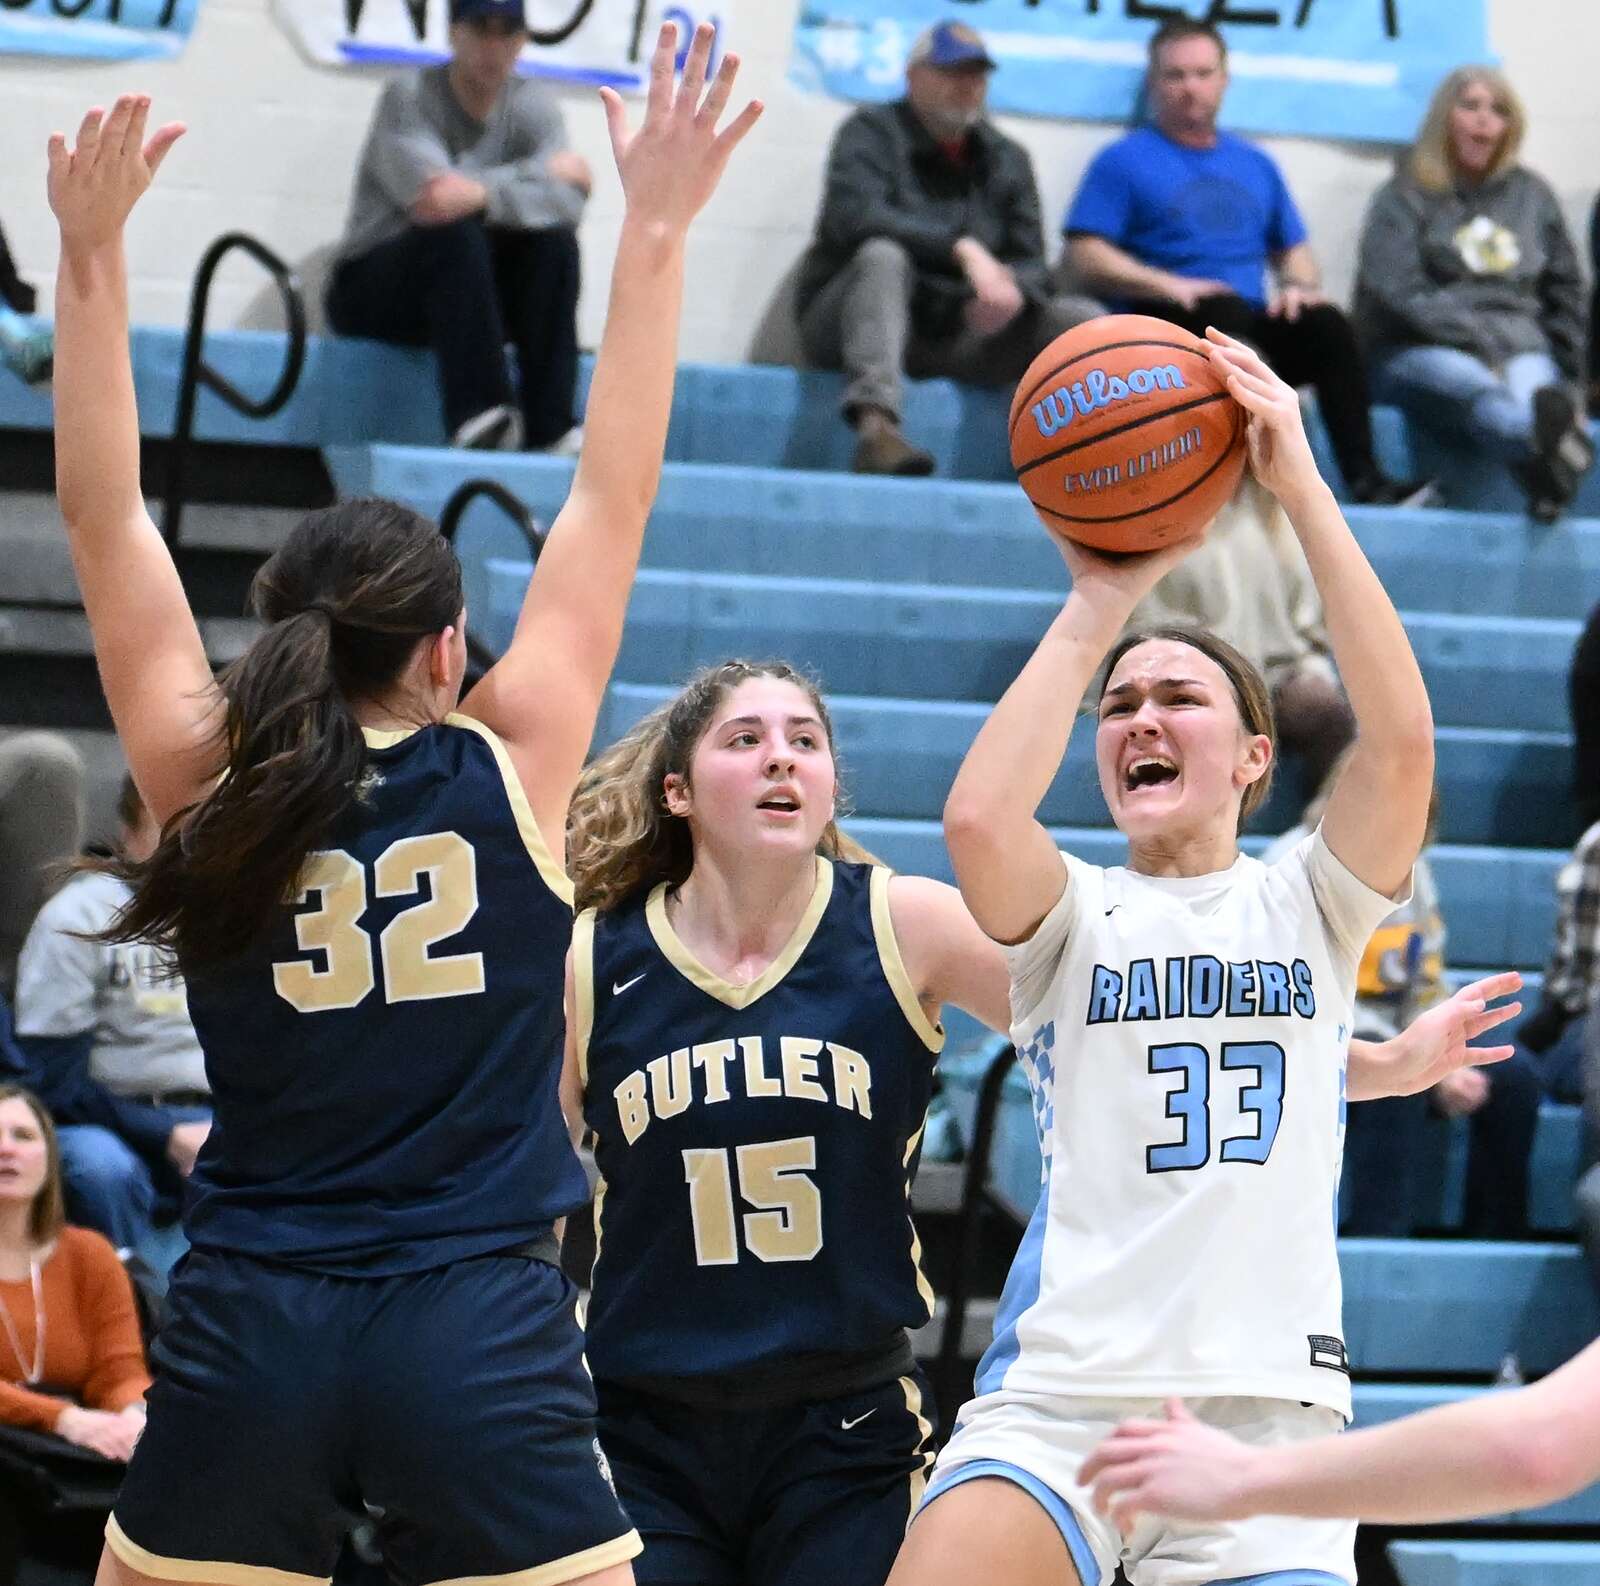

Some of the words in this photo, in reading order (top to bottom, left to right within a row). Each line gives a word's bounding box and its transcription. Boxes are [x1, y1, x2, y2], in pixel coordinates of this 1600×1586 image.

[1032, 363, 1187, 438] Wilson
[1064, 426, 1202, 493] EVOLUTION
[271, 830, 486, 1013] 32
[1086, 954, 1317, 1026] RAIDERS
[613, 1035, 873, 1147] BUTLER
[1146, 1040, 1286, 1175] 33
[681, 1135, 824, 1267] 15
